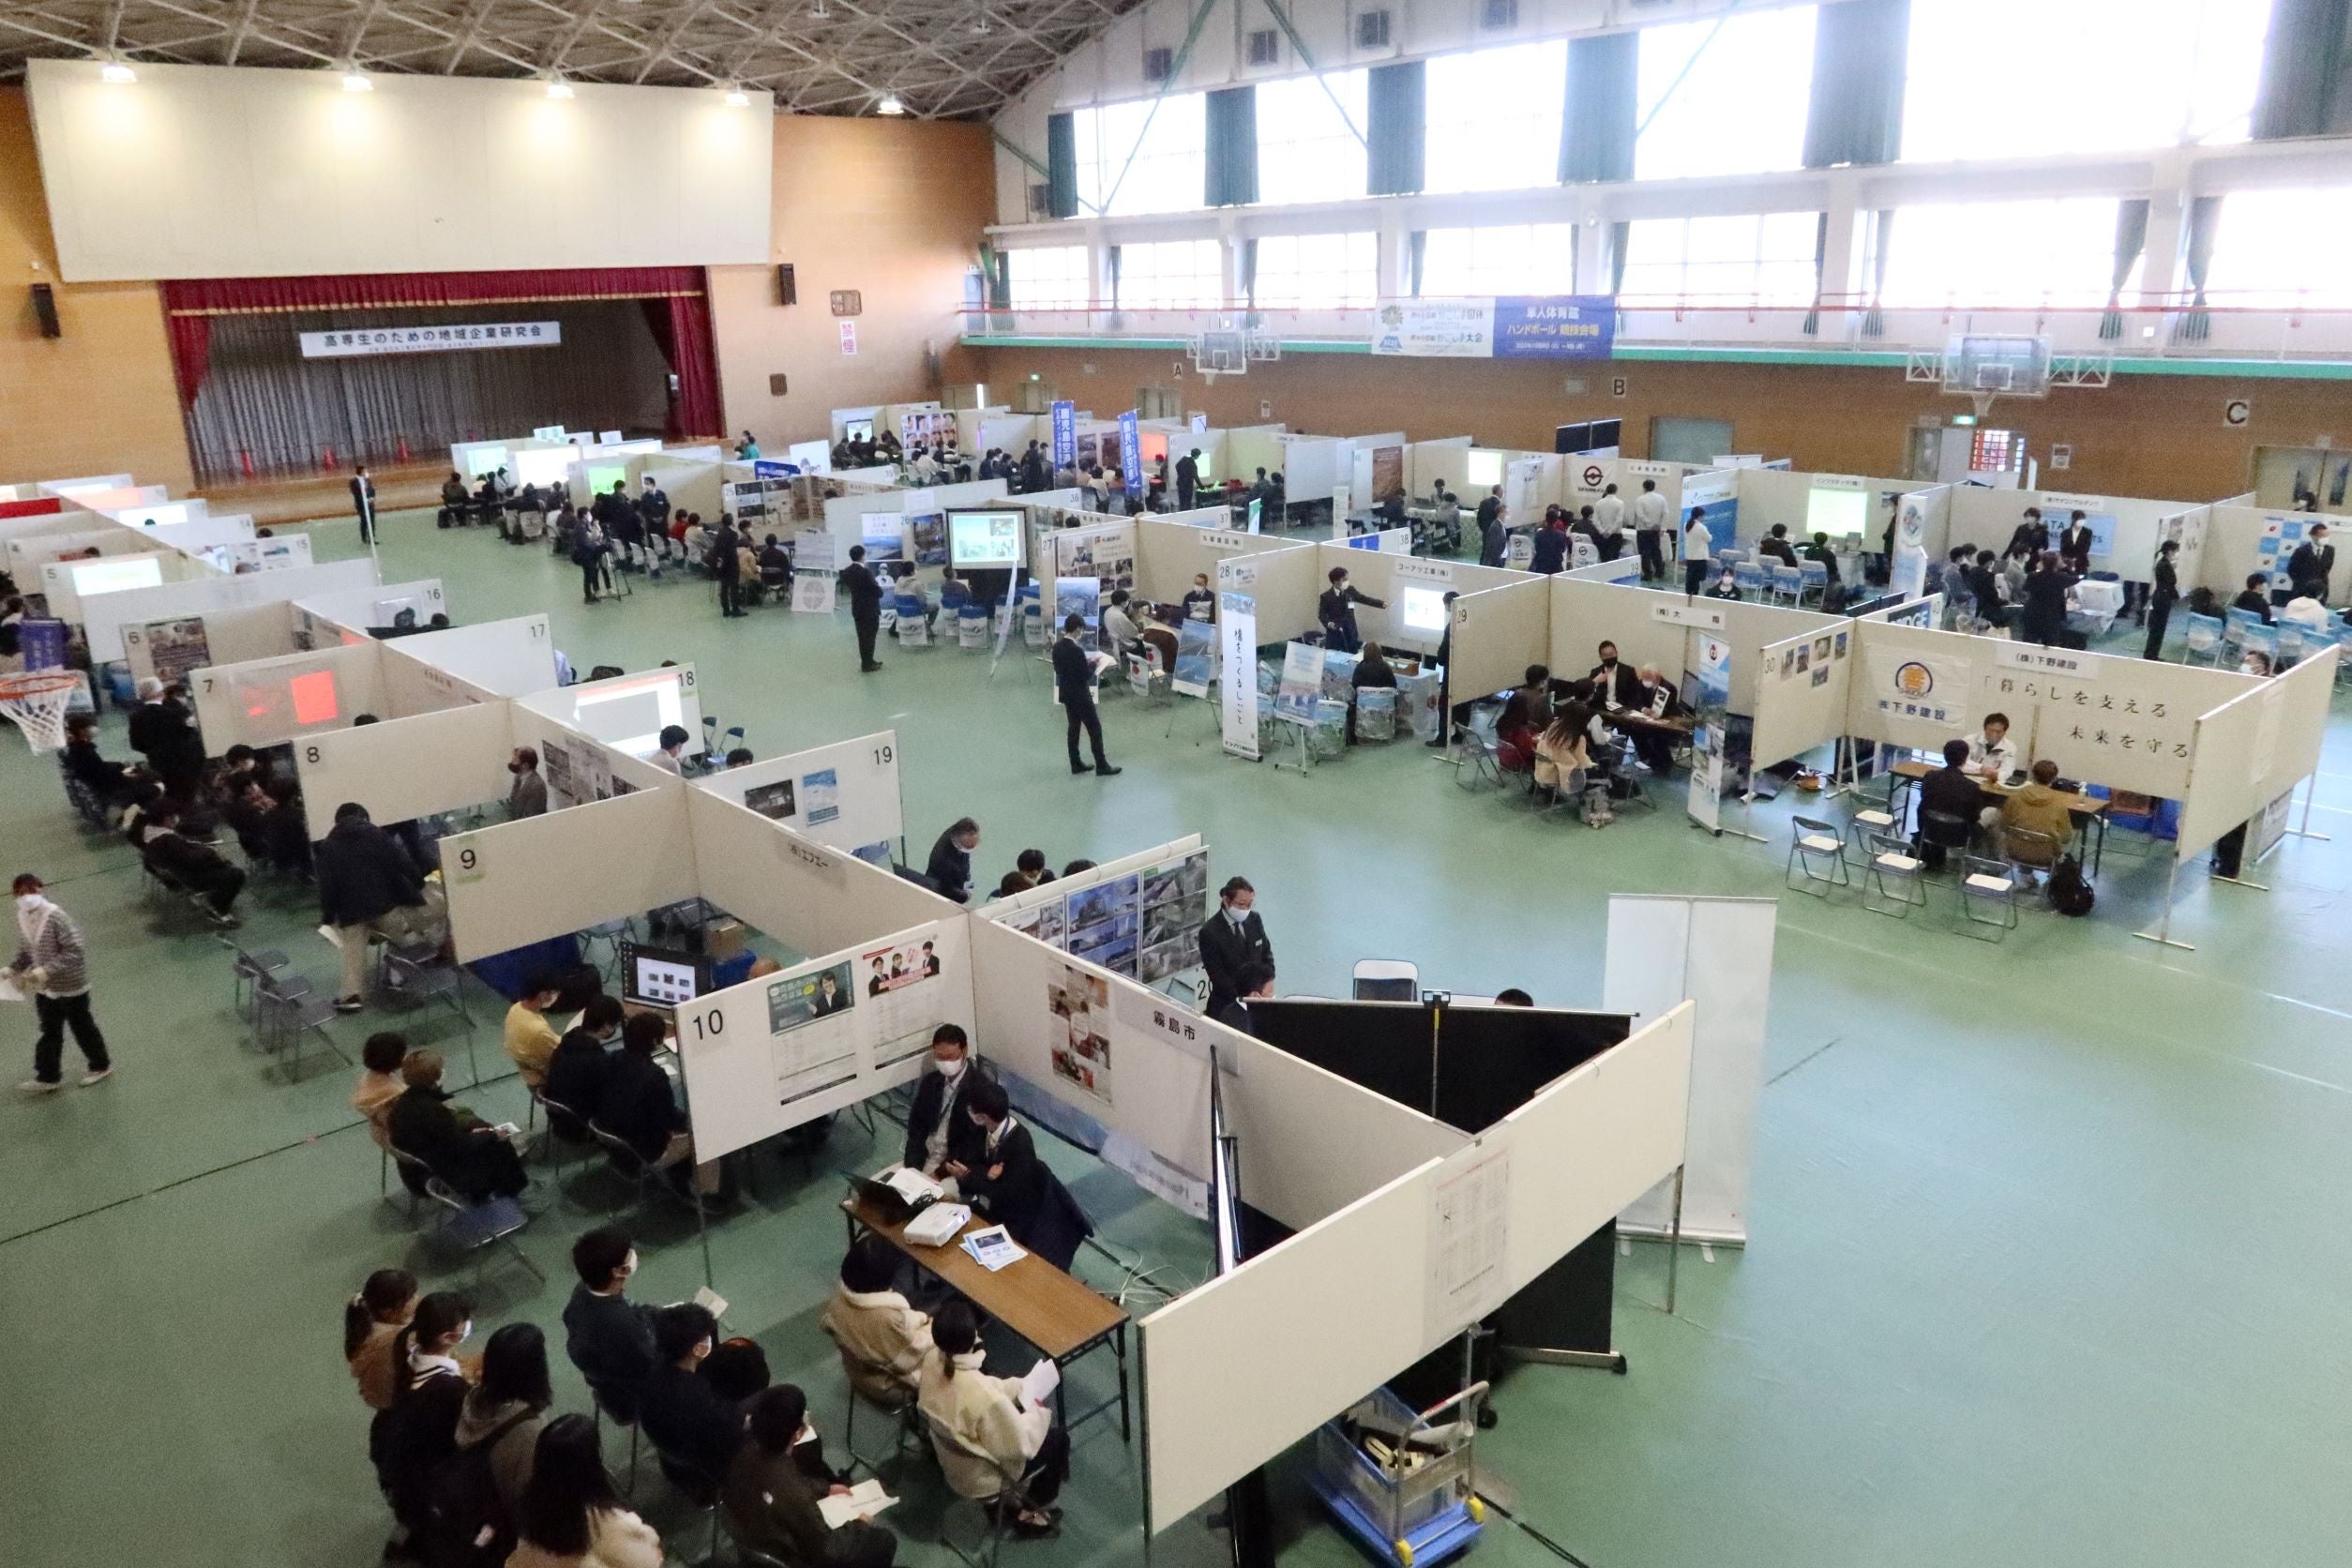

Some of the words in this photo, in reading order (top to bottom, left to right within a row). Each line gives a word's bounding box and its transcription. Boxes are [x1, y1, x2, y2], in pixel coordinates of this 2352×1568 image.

[324, 324, 542, 347] 高専生のための地域企業研究会
[1174, 364, 1182, 377] A
[1613, 379, 1625, 396] B
[2227, 401, 2248, 424] C
[1070, 494, 1078, 503] 36
[1220, 513, 1229, 523] 37
[1042, 539, 1052, 551] 27
[1400, 534, 1410, 545] 38
[46, 567, 56, 580] 5
[1220, 565, 1230, 579] 28
[1397, 563, 1449, 578] コーアツ工業(株)
[427, 588, 441, 600] 16
[1457, 609, 1468, 624] 29
[128, 631, 139, 644] 6
[530, 623, 545, 638] 17
[1765, 656, 1775, 674] 30
[2016, 653, 2079, 671] (株)下野建設
[677, 671, 695, 687] 18
[1233, 627, 1244, 726] 橋をつくるしごと
[203, 678, 213, 693] 7
[2070, 726, 2189, 759] 未来を守る
[307, 746, 320, 763] 8
[873, 746, 893, 765] 19
[460, 849, 476, 869] 9
[692, 1009, 723, 1041] 10
[1153, 1010, 1196, 1041] 霧島市
